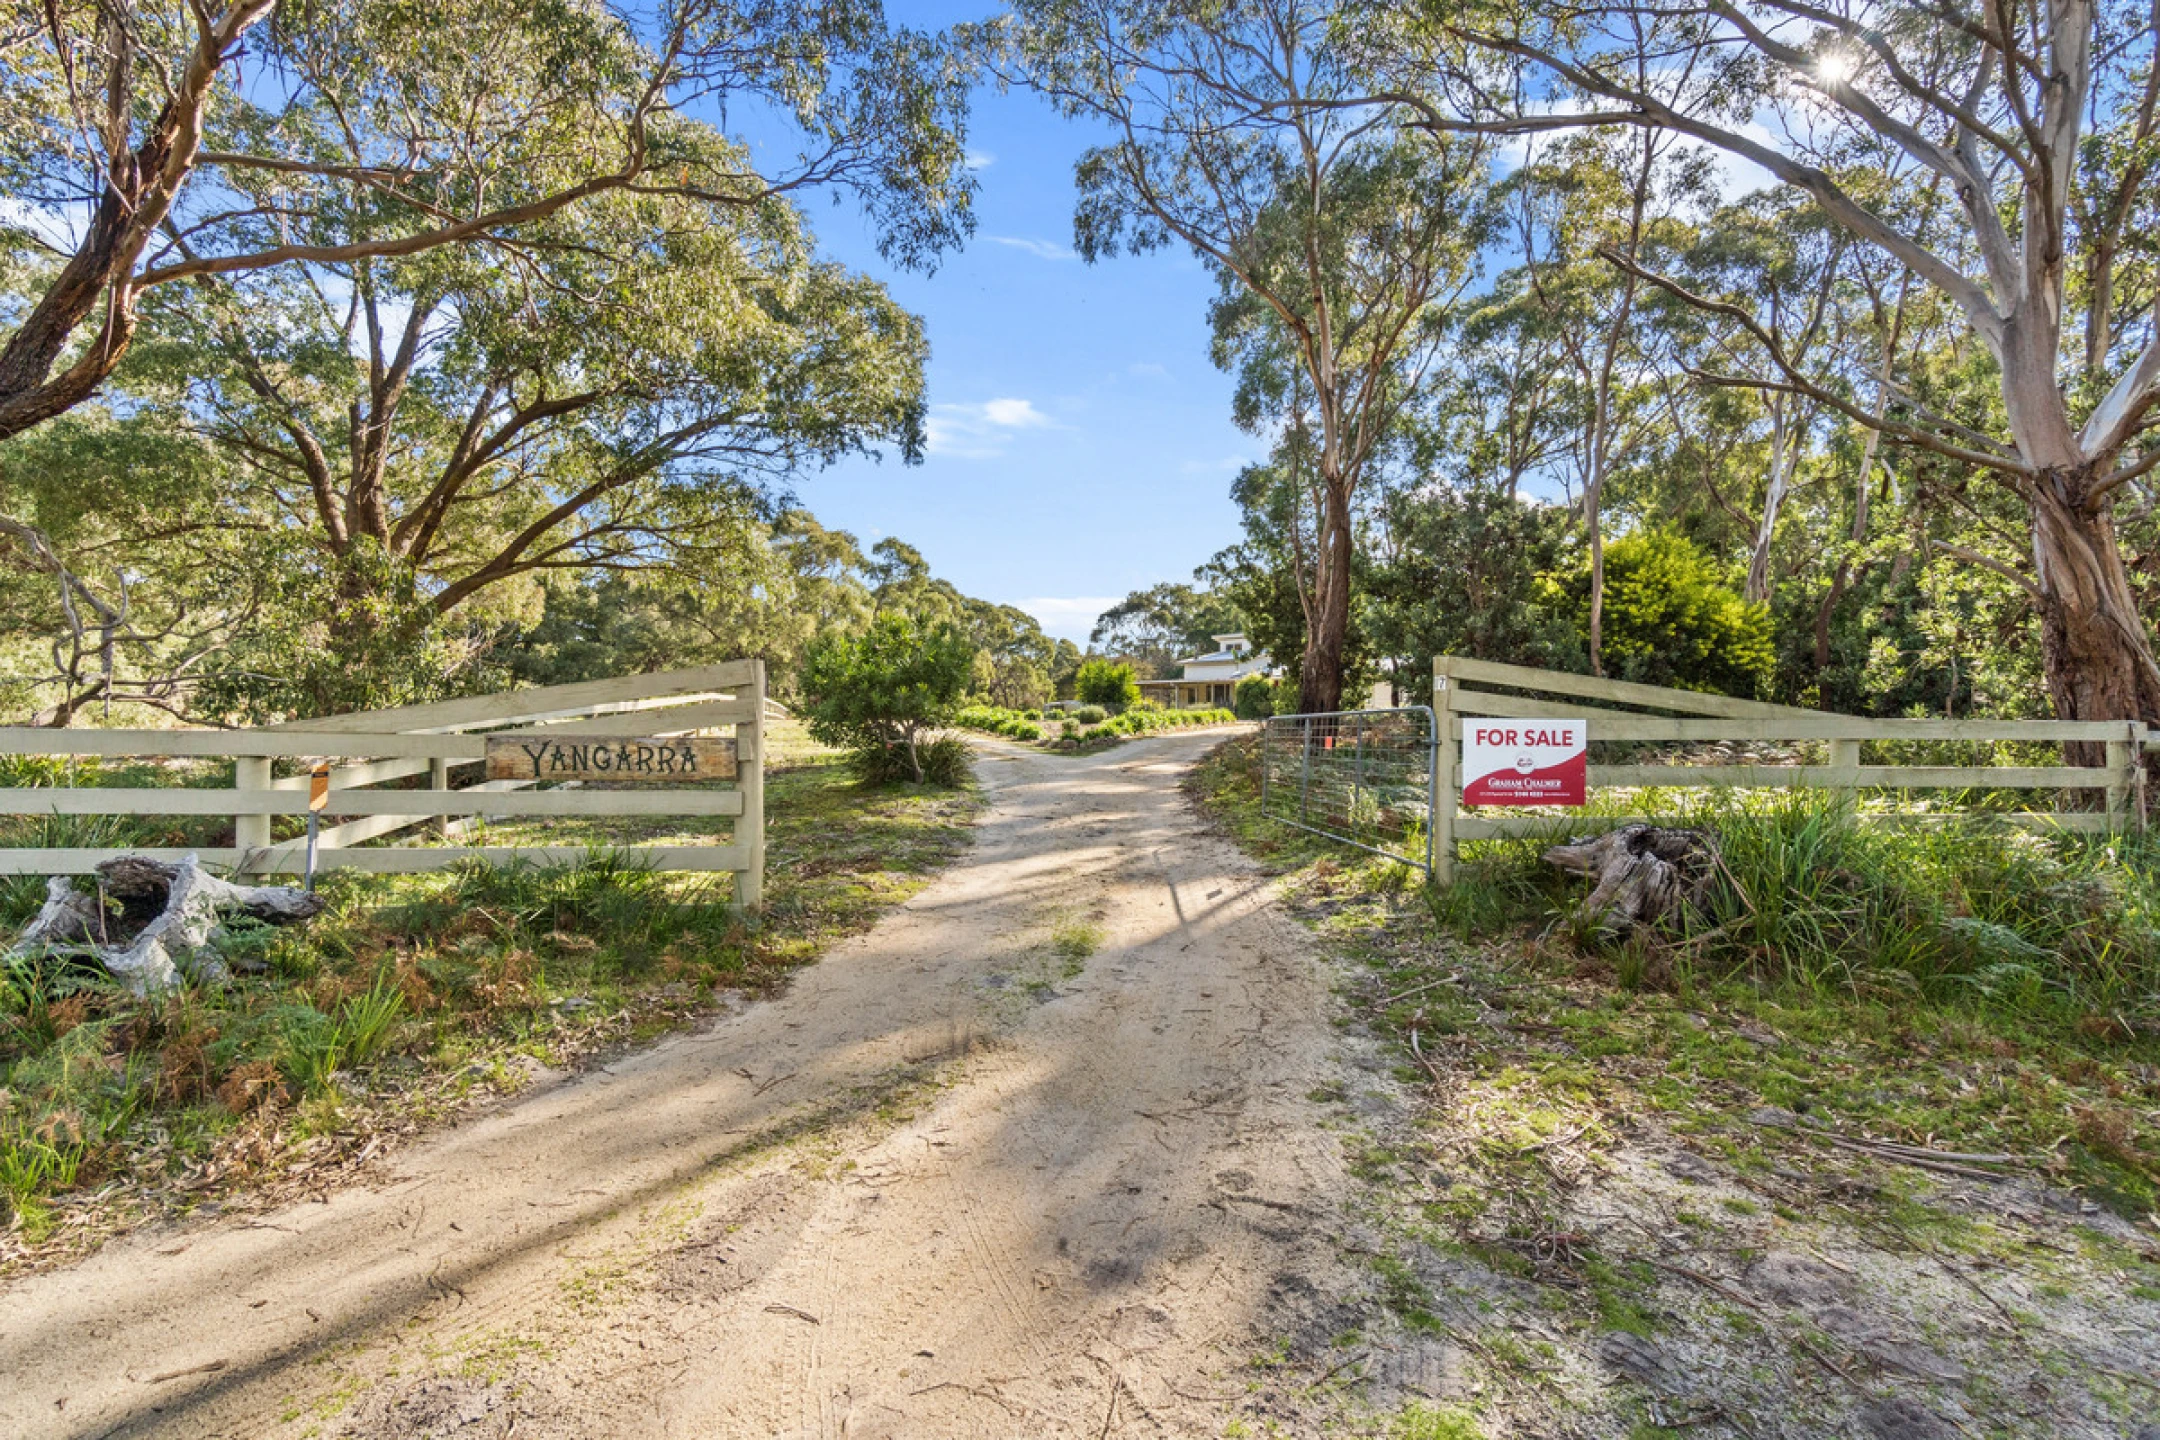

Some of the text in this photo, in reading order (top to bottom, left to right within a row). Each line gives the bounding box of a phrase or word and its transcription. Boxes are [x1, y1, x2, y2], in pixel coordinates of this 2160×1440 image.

[1475, 728, 1574, 747] FOR SALE
[522, 739, 697, 777] YANGARRA
